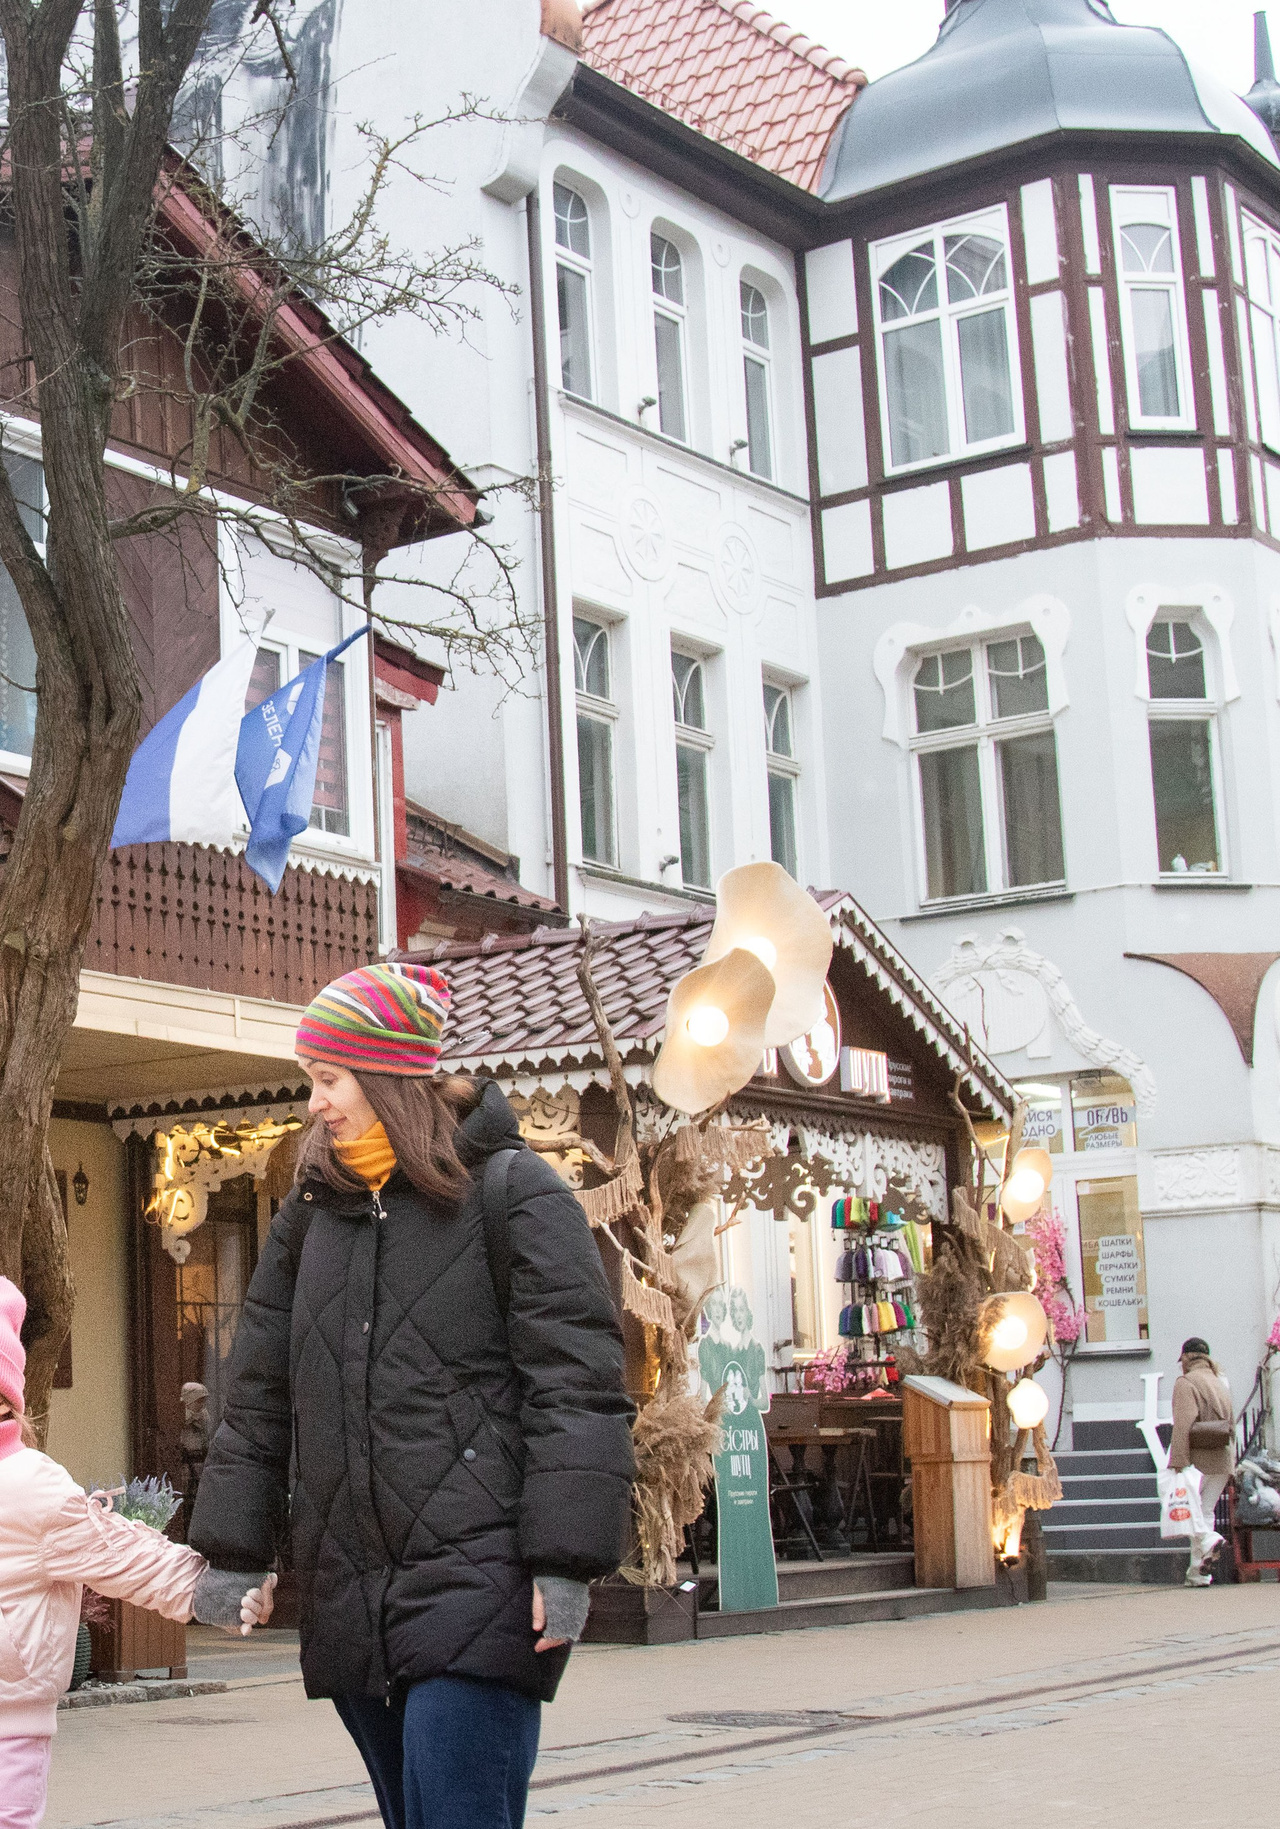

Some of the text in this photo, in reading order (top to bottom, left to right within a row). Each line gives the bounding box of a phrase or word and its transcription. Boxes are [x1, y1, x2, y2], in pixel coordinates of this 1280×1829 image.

[1024, 1109, 1052, 1122] ЙСЯ
[1089, 1132, 1119, 1142] ЛЮБЫЕ
[1086, 1140, 1123, 1150] РАЗМЕРЫ
[1101, 1238, 1132, 1247] ШАПКИ
[1101, 1250, 1134, 1259] ШАРФЫ
[1099, 1262, 1138, 1271] ПЕРЧАТКИ
[1104, 1274, 1135, 1283] СУМКИ
[1106, 1286, 1134, 1295] РЕМНИ
[1098, 1298, 1144, 1307] КОШЕЛЬКИ
